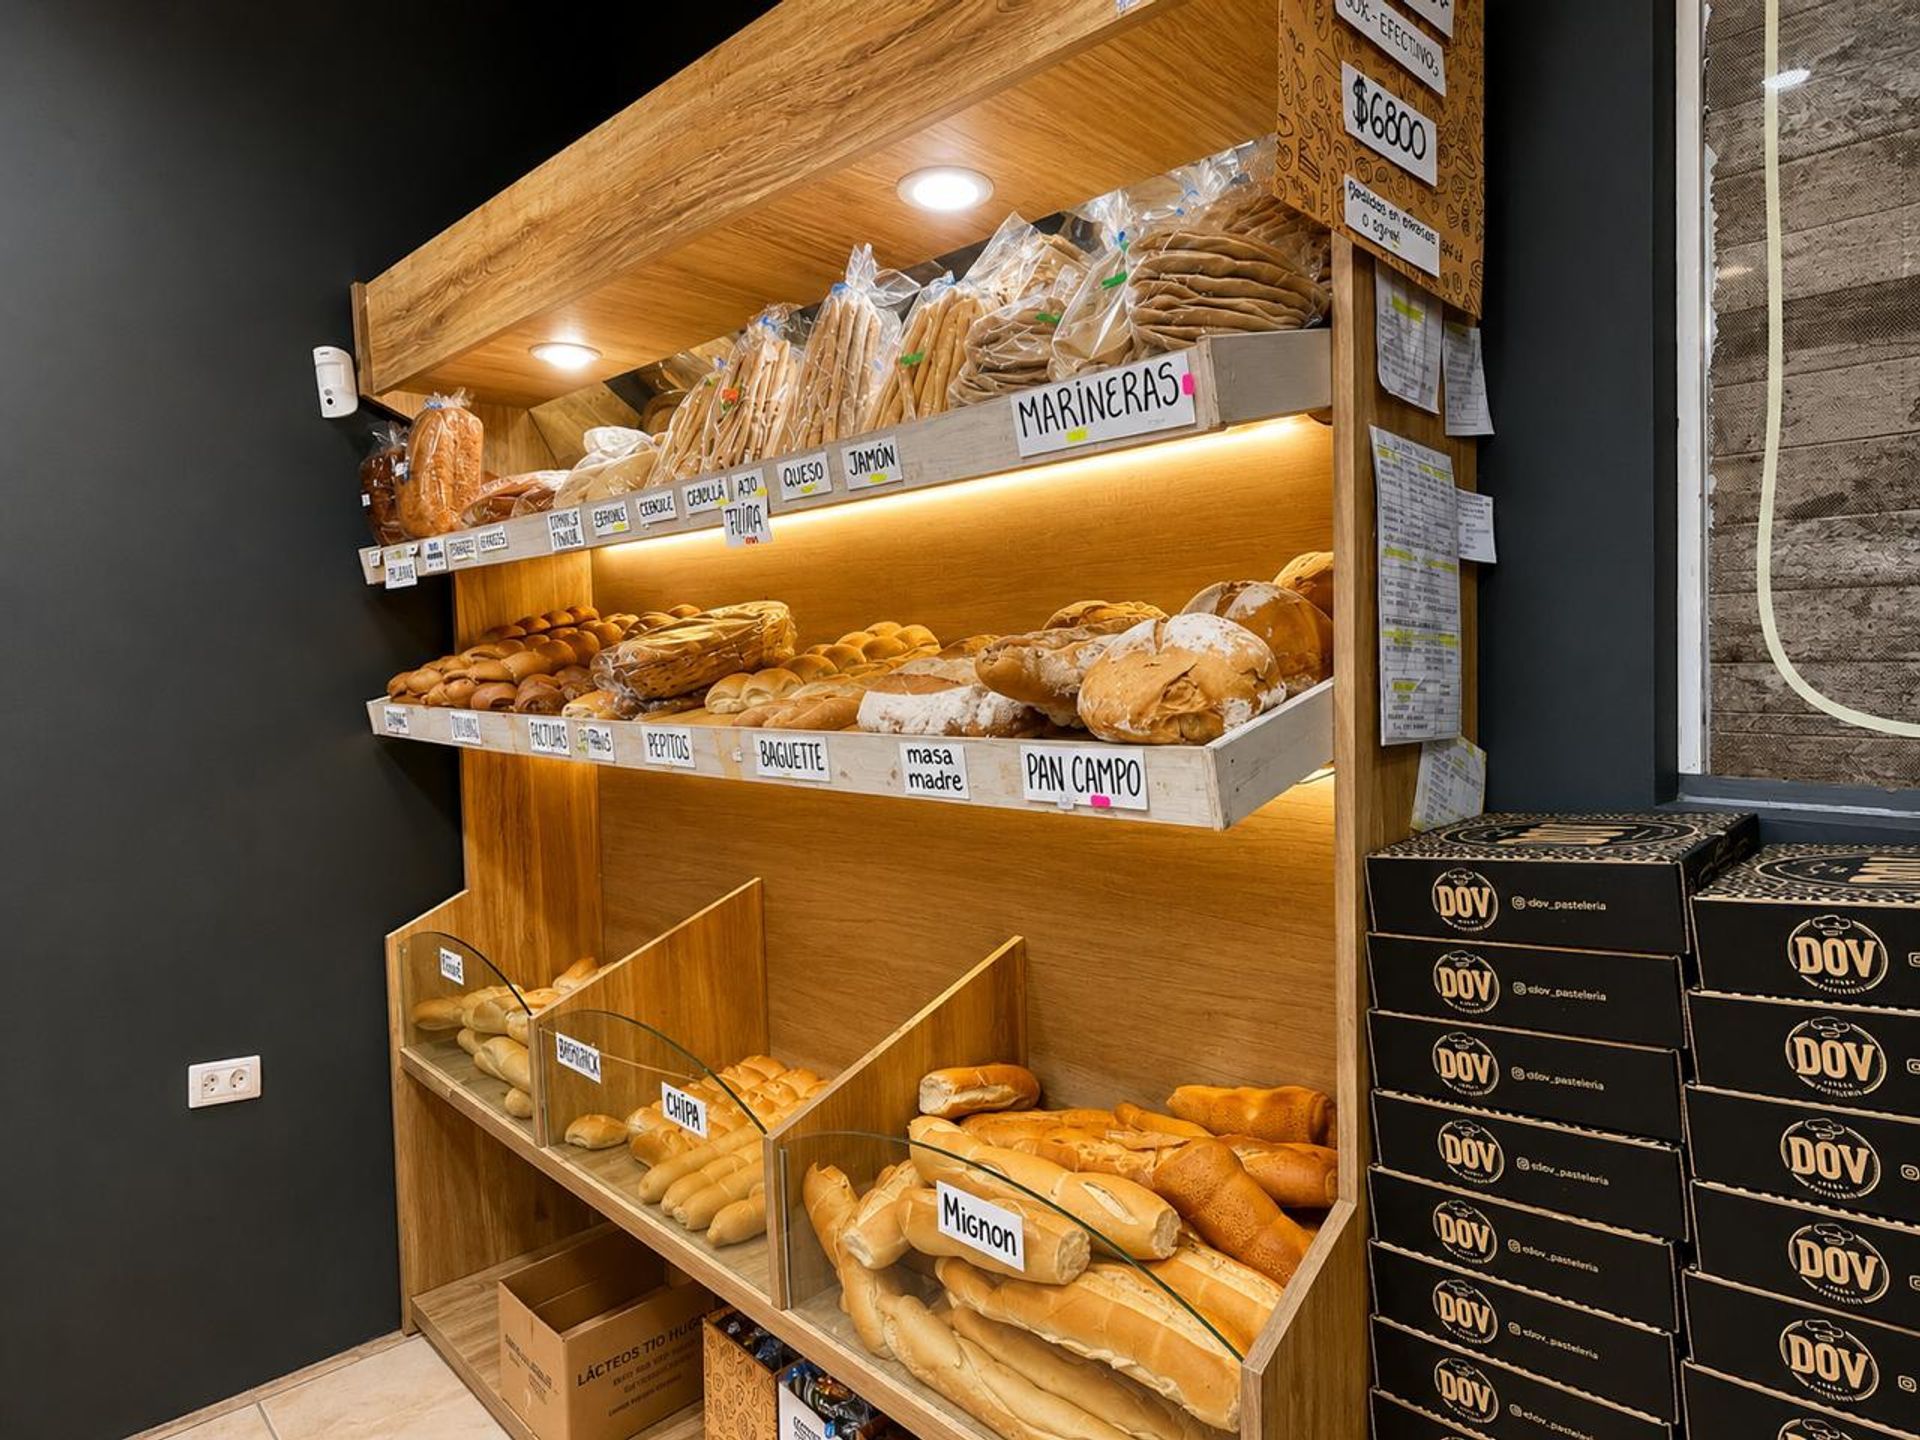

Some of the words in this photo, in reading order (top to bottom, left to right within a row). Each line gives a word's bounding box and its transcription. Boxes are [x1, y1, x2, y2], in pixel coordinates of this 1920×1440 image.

[1353, 75, 1426, 160] $6800
[784, 461, 823, 487] QUESO
[849, 442, 896, 475] JAMÓN
[738, 476, 757, 496] AJO
[648, 732, 690, 760] PEPITOS
[760, 740, 824, 771] BAGUETTE
[907, 748, 954, 765] masa
[908, 770, 963, 791] madre
[1027, 753, 1064, 791] PAN
[1072, 755, 1141, 796] CAMPO
[1436, 885, 1490, 918] DOV
[1794, 936, 1877, 978] DOV
[1438, 967, 1491, 1001] DOV
[1437, 1048, 1491, 1084] DOV
[1793, 1037, 1875, 1081] DOV
[1443, 1133, 1496, 1173] DOV
[1788, 1136, 1870, 1185] DOV
[944, 1192, 1016, 1256] Mignon
[1438, 1213, 1490, 1253] DOV
[1797, 1239, 1879, 1291] DOV
[1438, 1291, 1490, 1334] DOV
[1788, 1334, 1869, 1389] DOV
[1439, 1369, 1491, 1413] DOV
